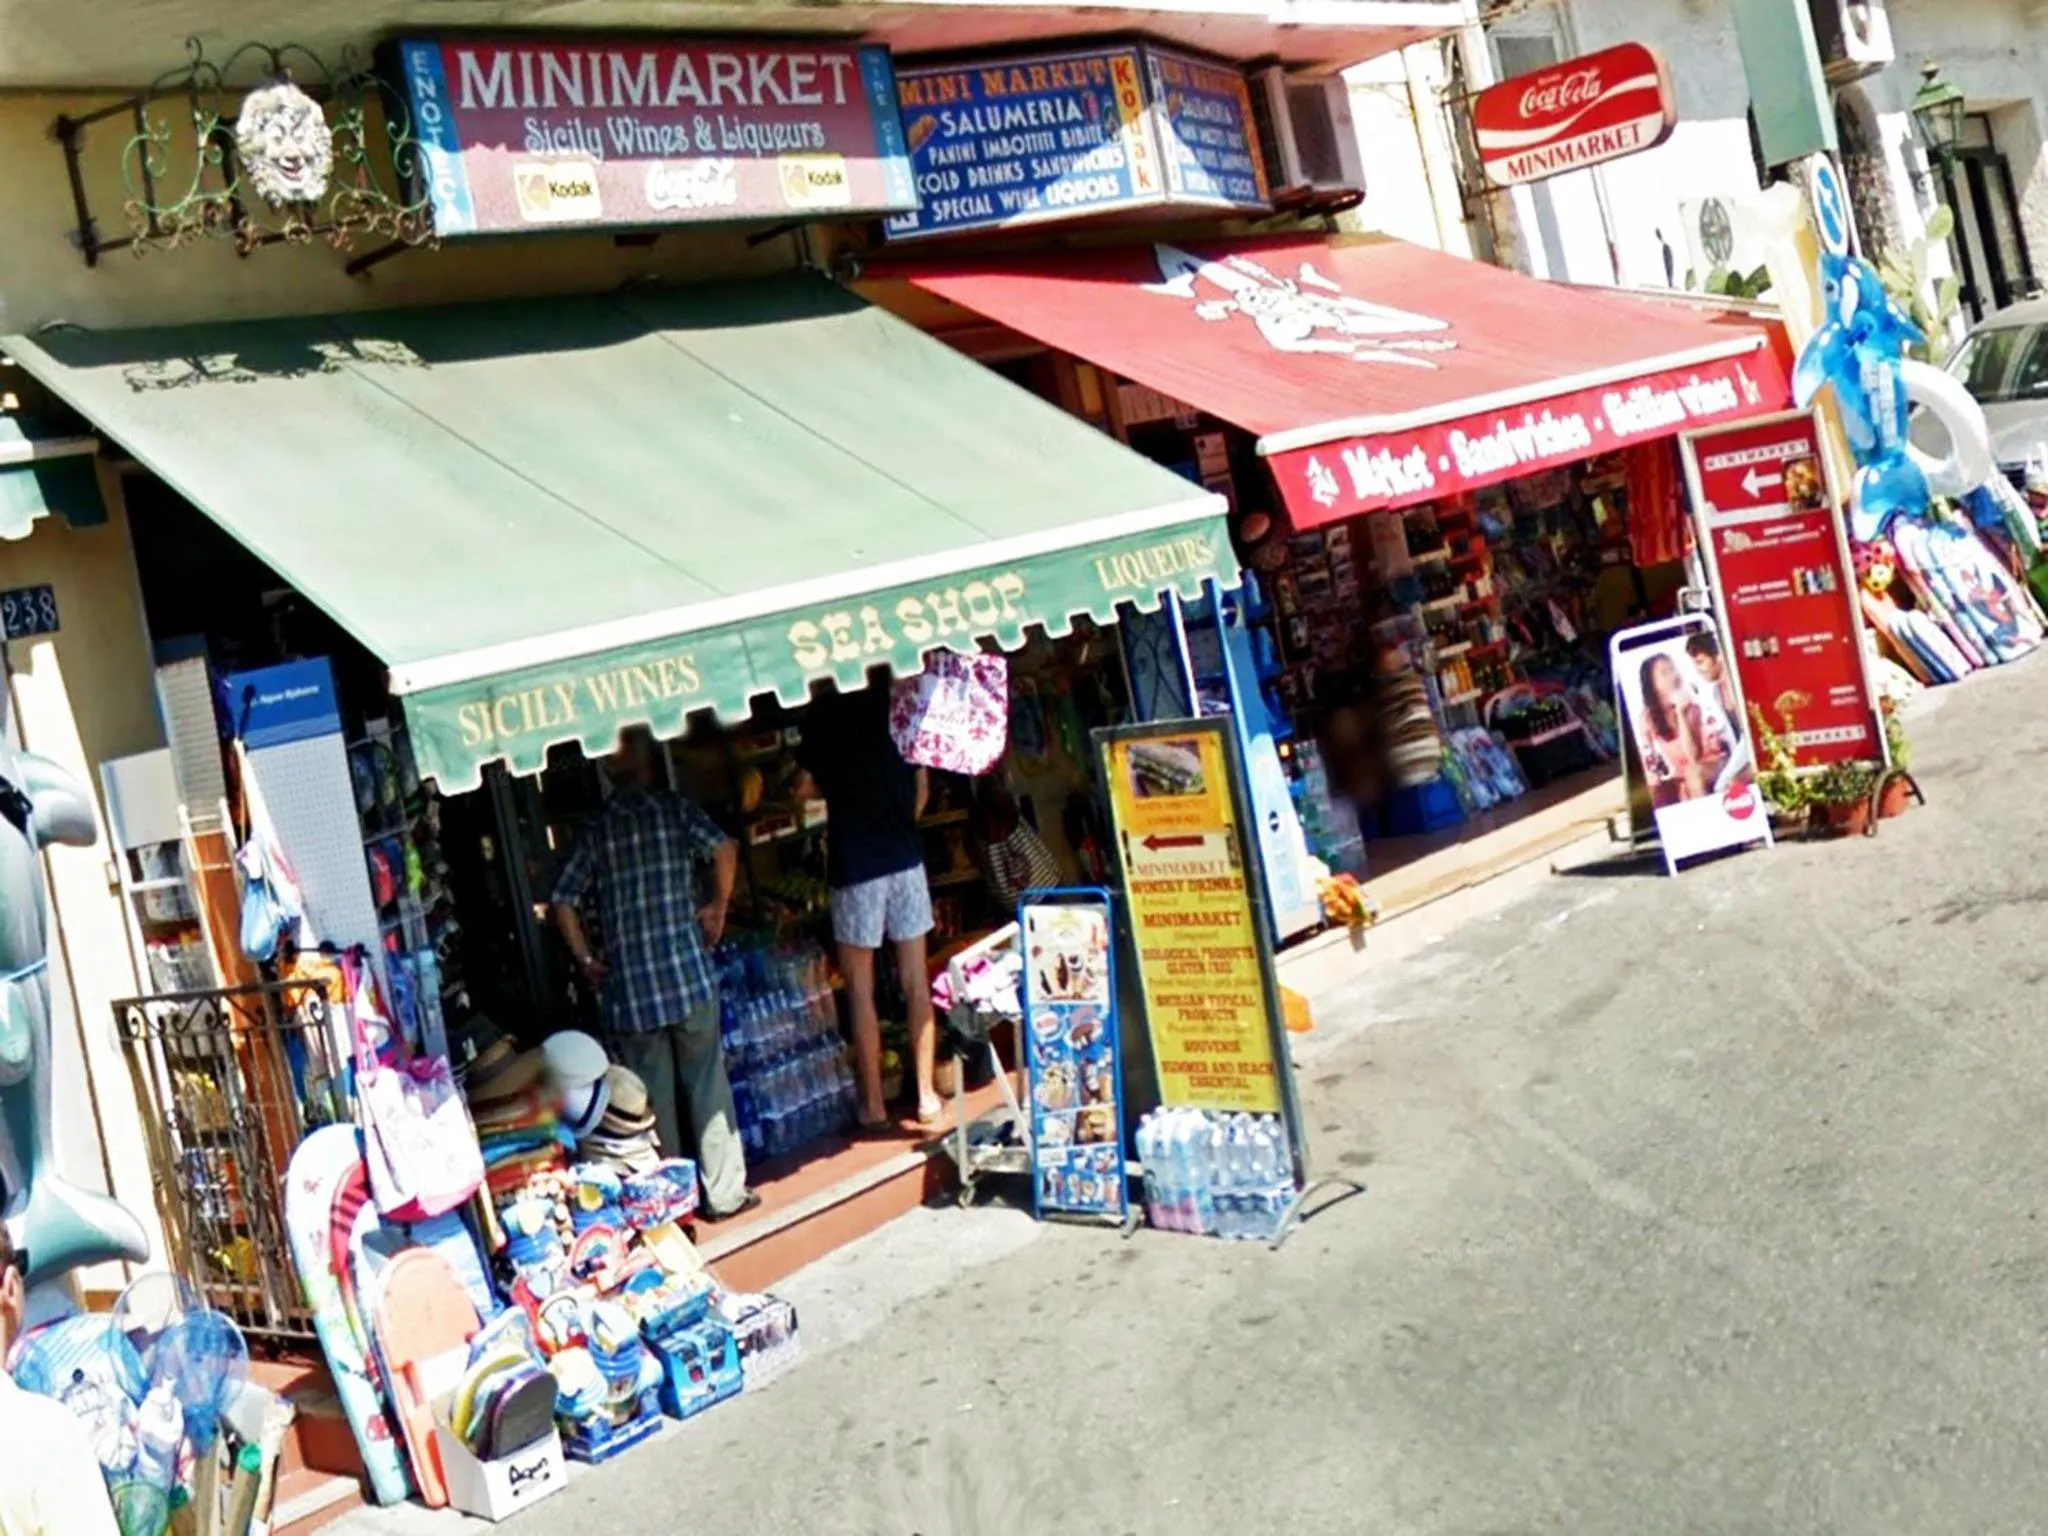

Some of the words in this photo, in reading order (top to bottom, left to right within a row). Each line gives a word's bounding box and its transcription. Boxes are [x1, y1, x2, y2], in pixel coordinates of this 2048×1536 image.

[456, 50, 853, 109] MINIMARKET
[898, 73, 973, 106] MINI
[982, 58, 1107, 96] MARKET
[412, 50, 463, 228] ENOTECA
[524, 115, 603, 163] Sicily
[606, 114, 689, 156] Wines
[693, 114, 716, 151] &
[718, 113, 826, 157] Liqueurs
[940, 96, 1083, 138] SALUMERIA
[1113, 59, 1152, 188] Kodak
[928, 142, 977, 166] PANINI
[1507, 122, 1641, 178] MINIMARKET
[549, 180, 593, 199] Kodak
[808, 171, 843, 187] Kodak
[917, 169, 960, 194] COLD
[967, 160, 1025, 189] DRINKS
[932, 193, 994, 221] SPECIAL
[1341, 444, 1435, 500] Market
[1449, 408, 1592, 478] Sandwiches
[1096, 535, 1214, 590] LIQUEURS
[3, 591, 56, 631] 238
[787, 606, 896, 669] SEA
[896, 572, 1025, 643] SHOP
[457, 679, 579, 747] SICILY
[586, 654, 700, 713] WINES
[1138, 860, 1225, 876] MINIMARKET
[1143, 911, 1241, 928] MINIMARKET
